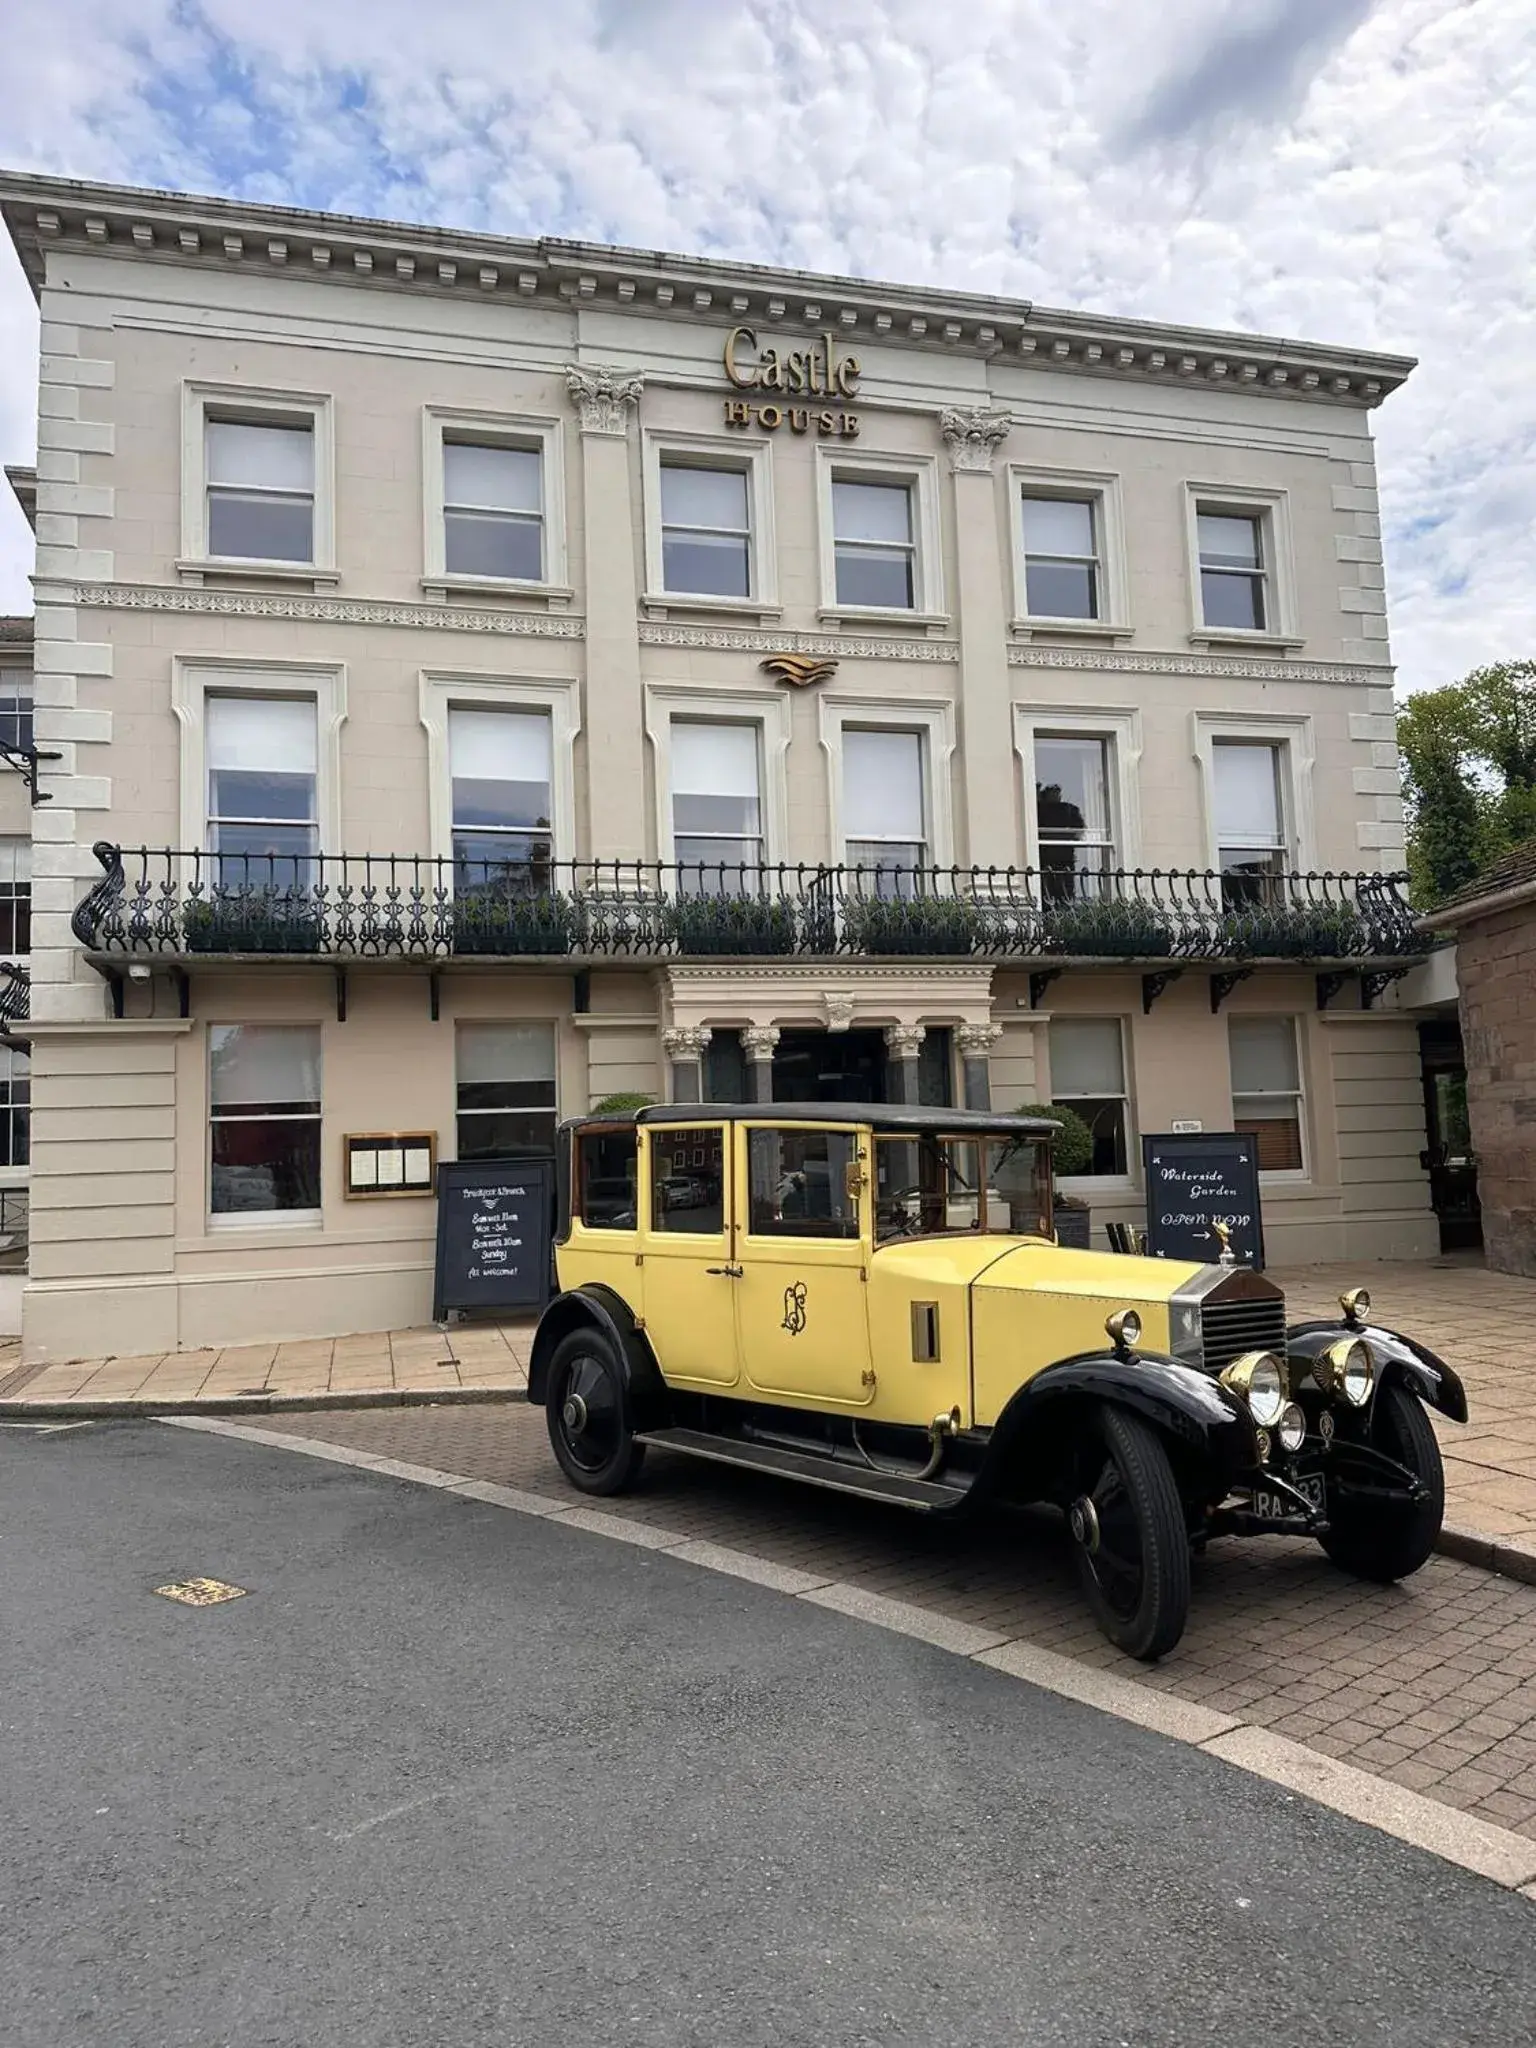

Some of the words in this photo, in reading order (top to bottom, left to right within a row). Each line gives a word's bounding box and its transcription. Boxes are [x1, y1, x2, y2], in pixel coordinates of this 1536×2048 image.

[725, 326, 862, 399] Castle
[724, 401, 860, 438] HOUSE
[1161, 1168, 1223, 1180] Waterside
[1189, 1185, 1236, 1199] Garden
[1161, 1213, 1208, 1225] OPEN
[481, 1249, 507, 1261] Sunday
